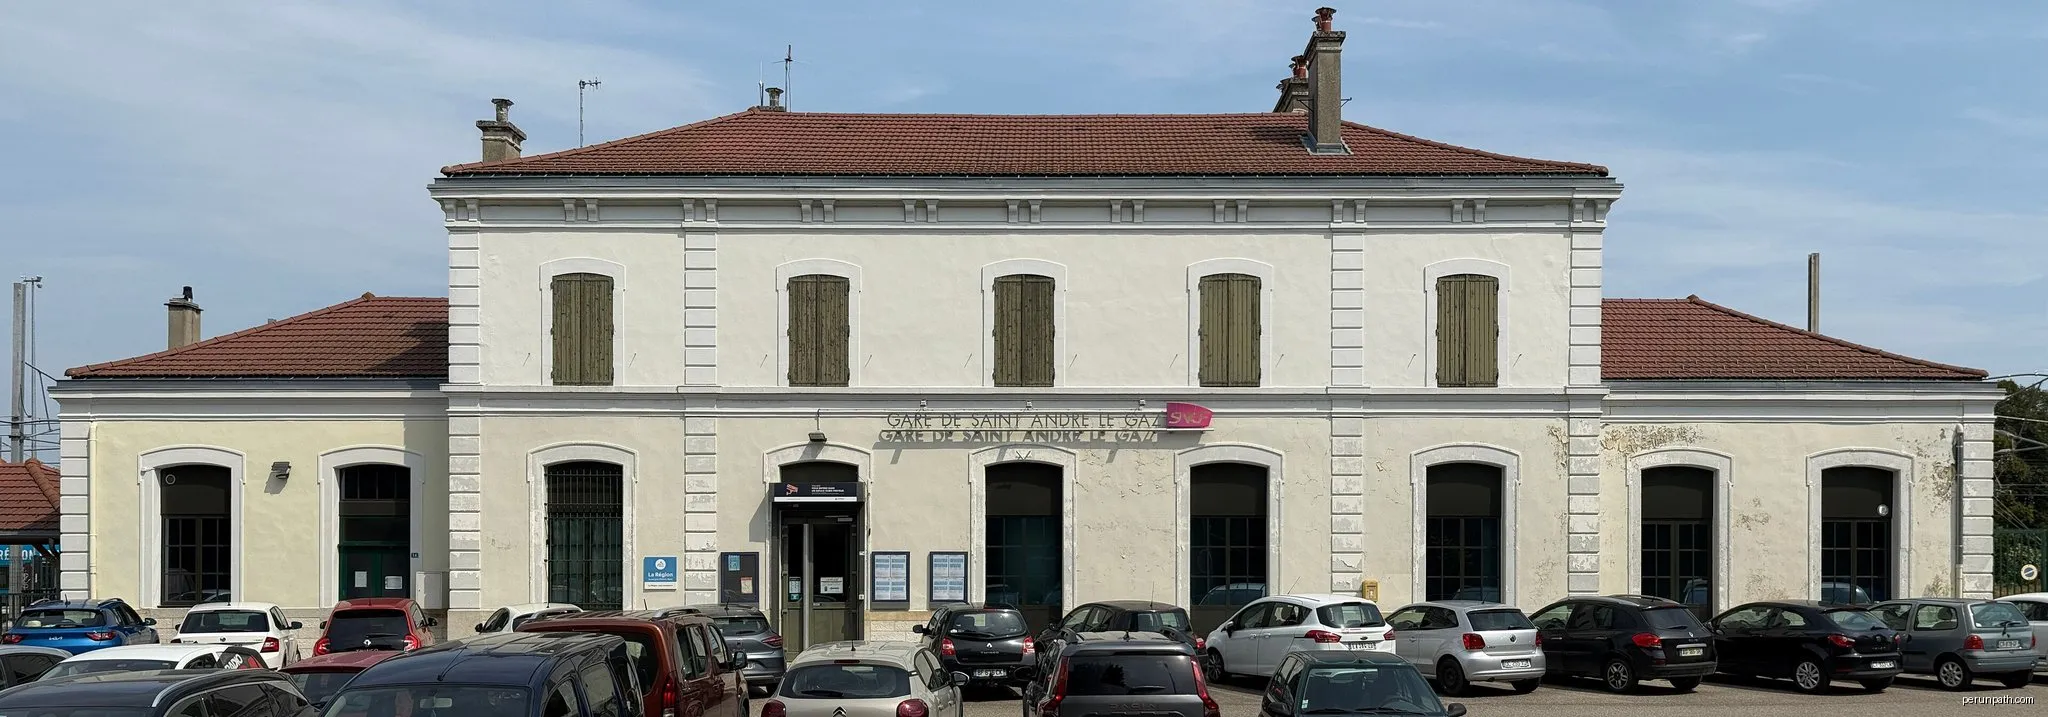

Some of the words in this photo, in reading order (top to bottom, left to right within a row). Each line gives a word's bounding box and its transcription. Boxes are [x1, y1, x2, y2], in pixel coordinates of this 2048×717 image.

[887, 412, 931, 428] GARE
[941, 412, 962, 428] DE
[971, 412, 1021, 428] SAINT
[1031, 412, 1090, 428] ANDRE
[1099, 412, 1115, 428] LE
[1125, 412, 1160, 428] GAZ
